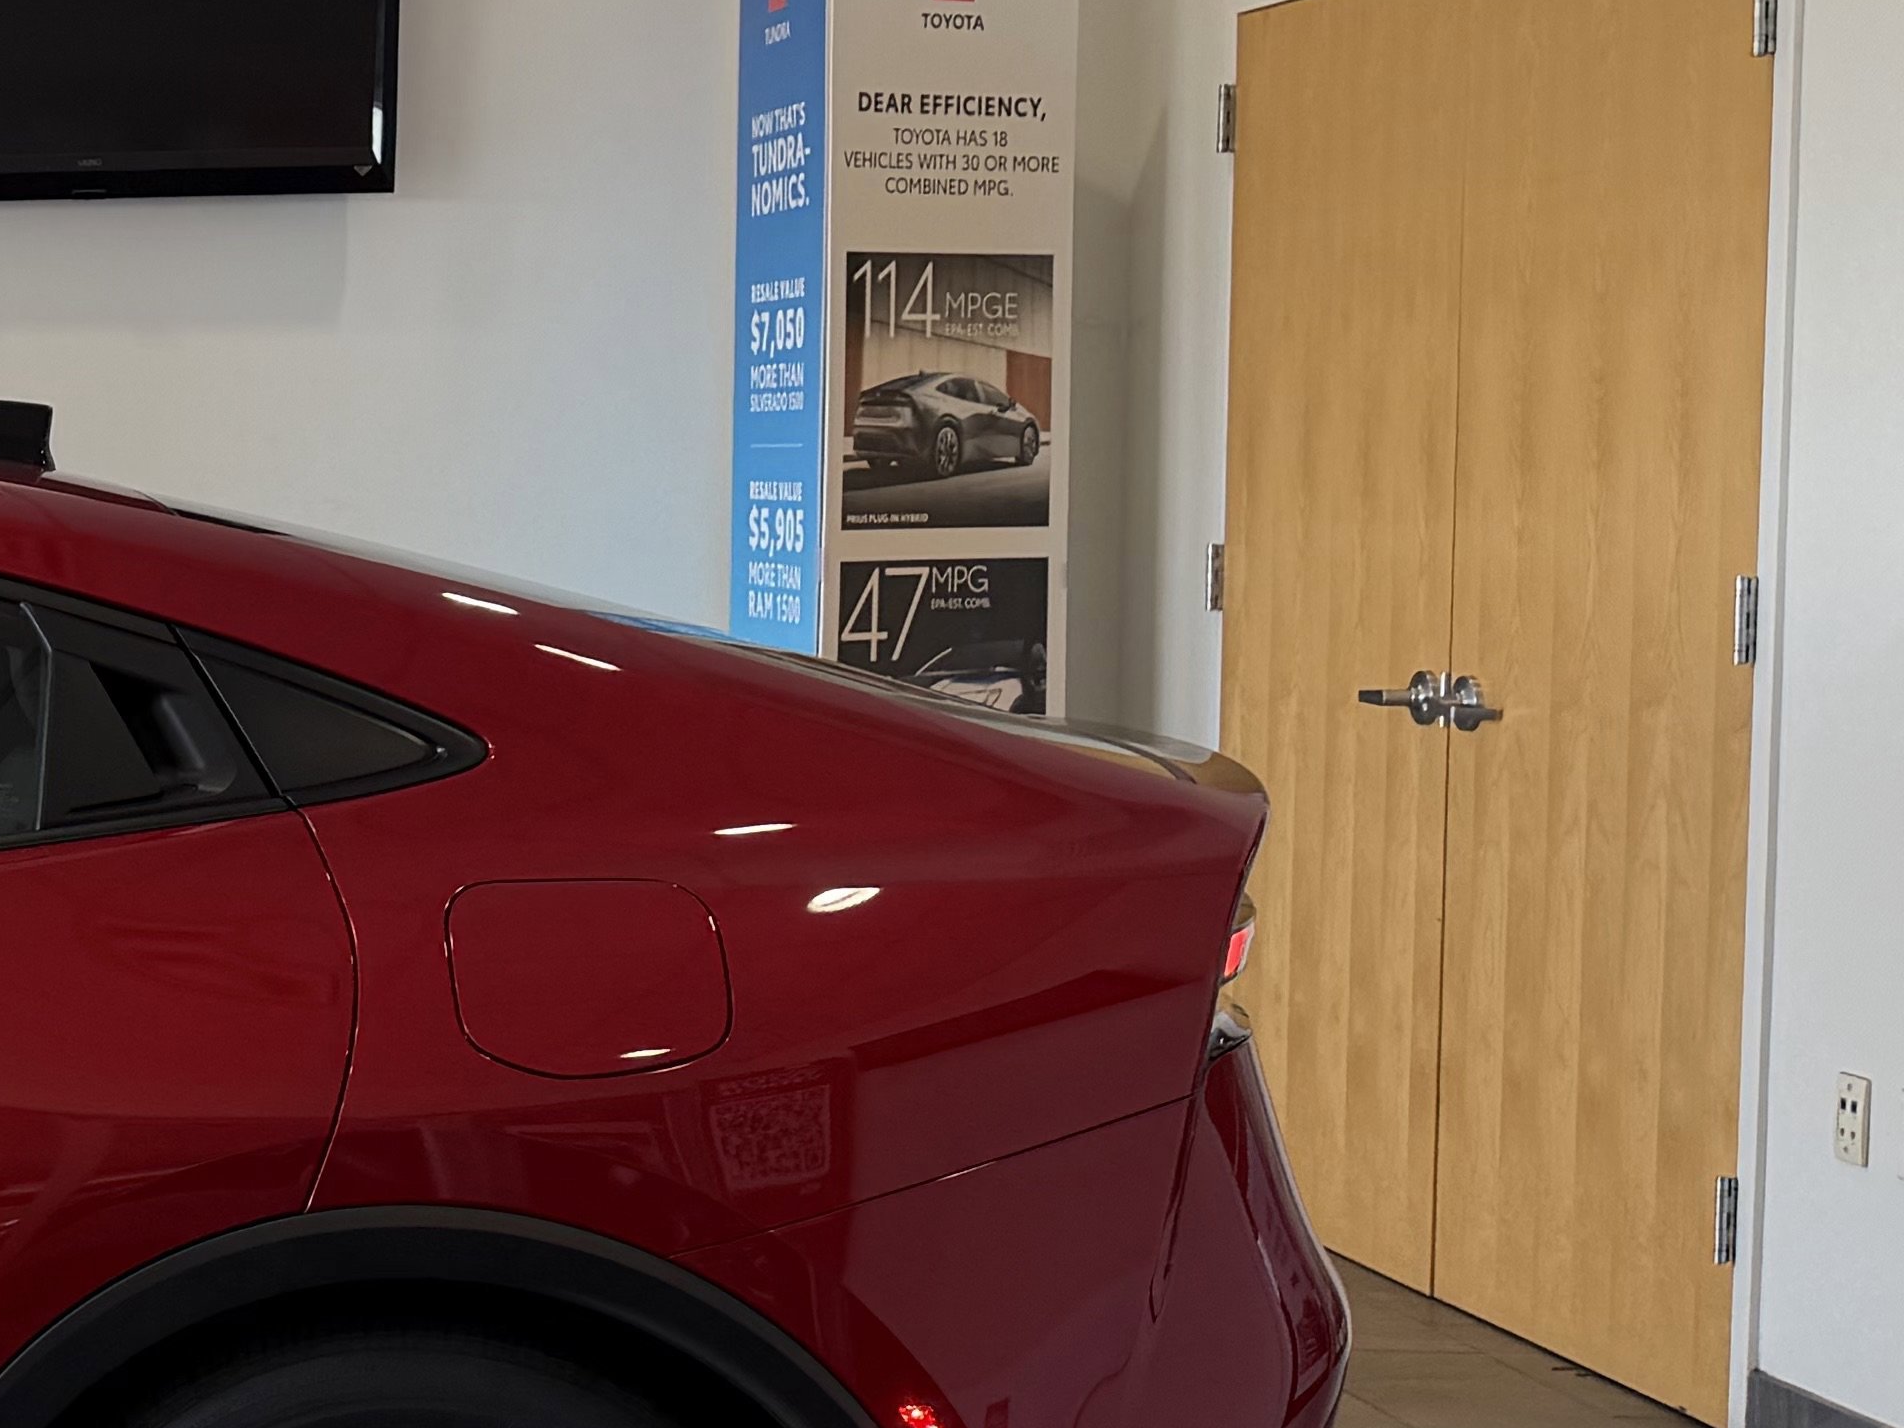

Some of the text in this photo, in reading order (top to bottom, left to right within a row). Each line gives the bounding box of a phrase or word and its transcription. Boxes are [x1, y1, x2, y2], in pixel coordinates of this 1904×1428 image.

[922, 12, 984, 31] TOYOTA
[858, 91, 1046, 122] DEAR EFFICIENCY,
[752, 110, 773, 137] NOW
[893, 128, 1008, 148] TOYOTA HAS 18
[752, 132, 811, 177] TUNDRA-
[844, 151, 1060, 173] VEHICLES WITH 30 OR MORE
[751, 172, 810, 217] NOMICS.
[885, 177, 1014, 197] COMBINED MPG.
[853, 259, 941, 338] 114
[945, 292, 1018, 320] MPGE
[751, 307, 805, 359] $7,050
[751, 361, 805, 389] MORE THAN
[749, 481, 778, 501] RESALE
[749, 503, 804, 558] $5,905
[749, 561, 801, 590] MORE THAN
[931, 565, 989, 593] MPG
[748, 590, 801, 624] RAM 1500
[841, 565, 930, 662] 47
